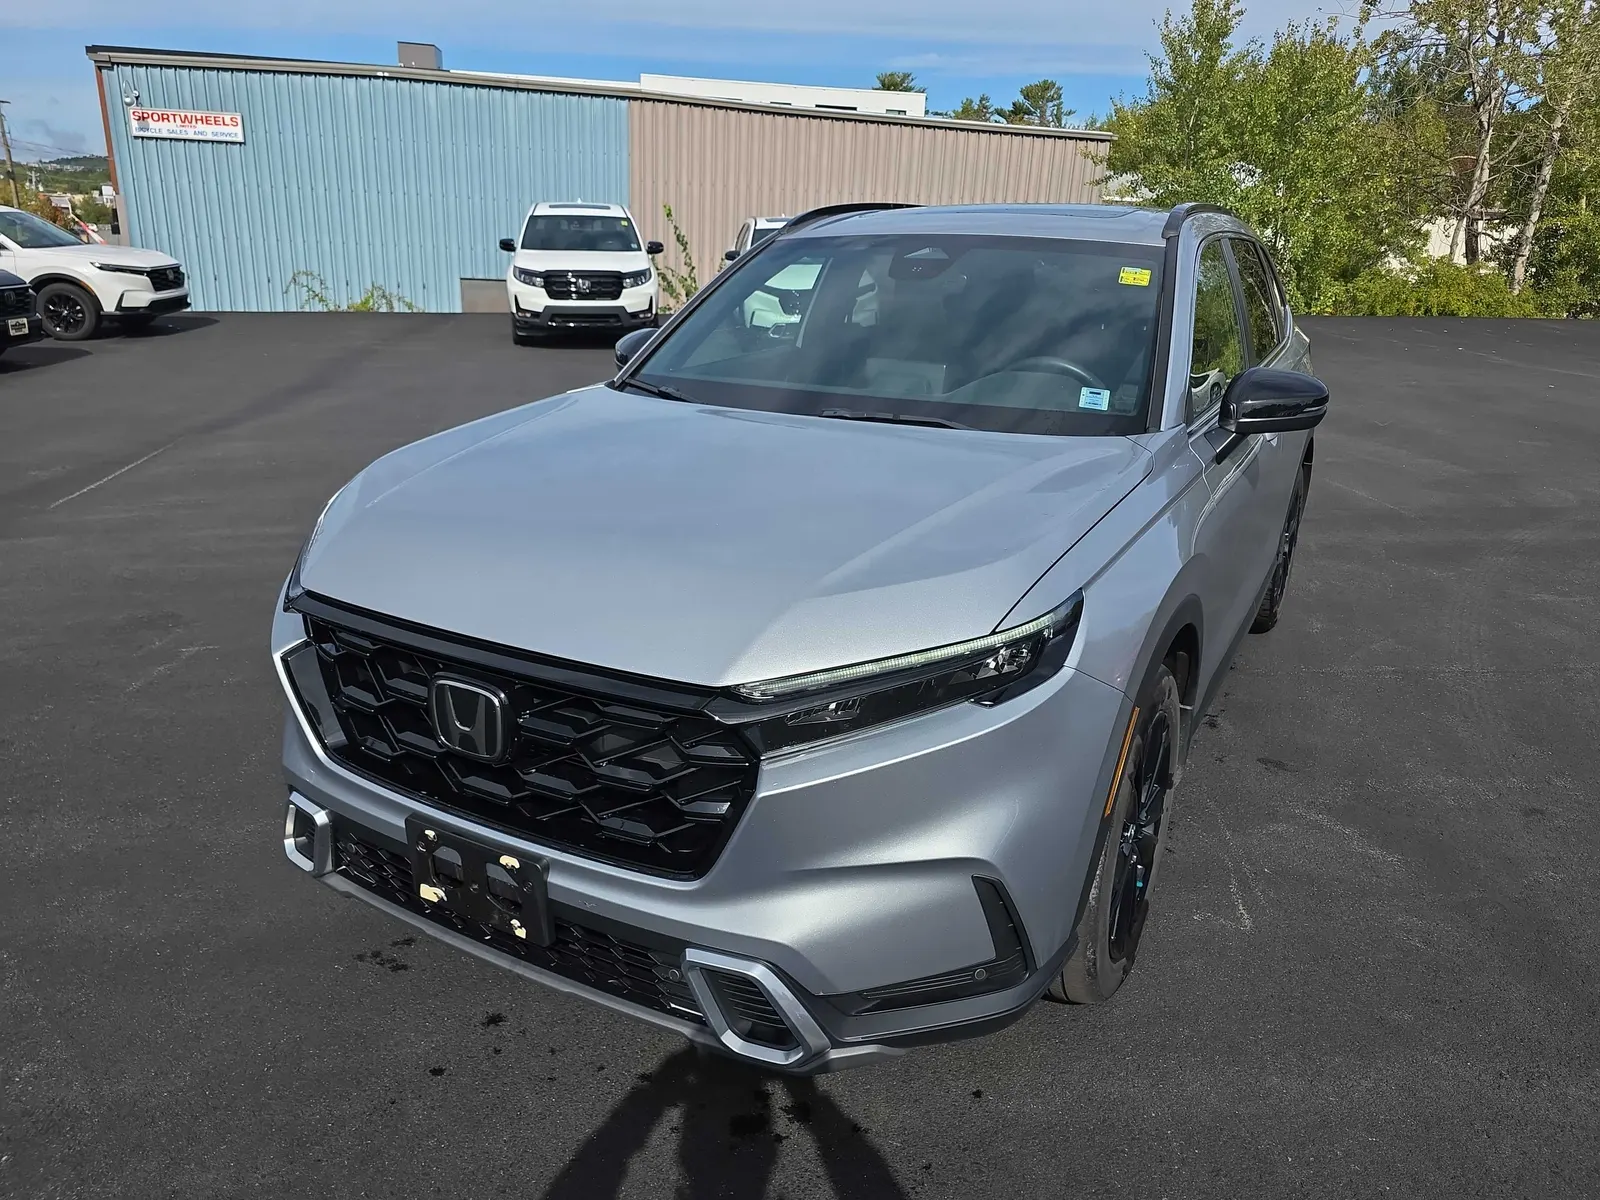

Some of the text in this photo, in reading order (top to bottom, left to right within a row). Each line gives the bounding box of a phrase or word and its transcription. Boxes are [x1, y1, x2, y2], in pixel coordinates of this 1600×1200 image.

[132, 110, 239, 127] SPORTWHEELS
[167, 128, 189, 136] SALES
[211, 131, 239, 139] SERVICE
